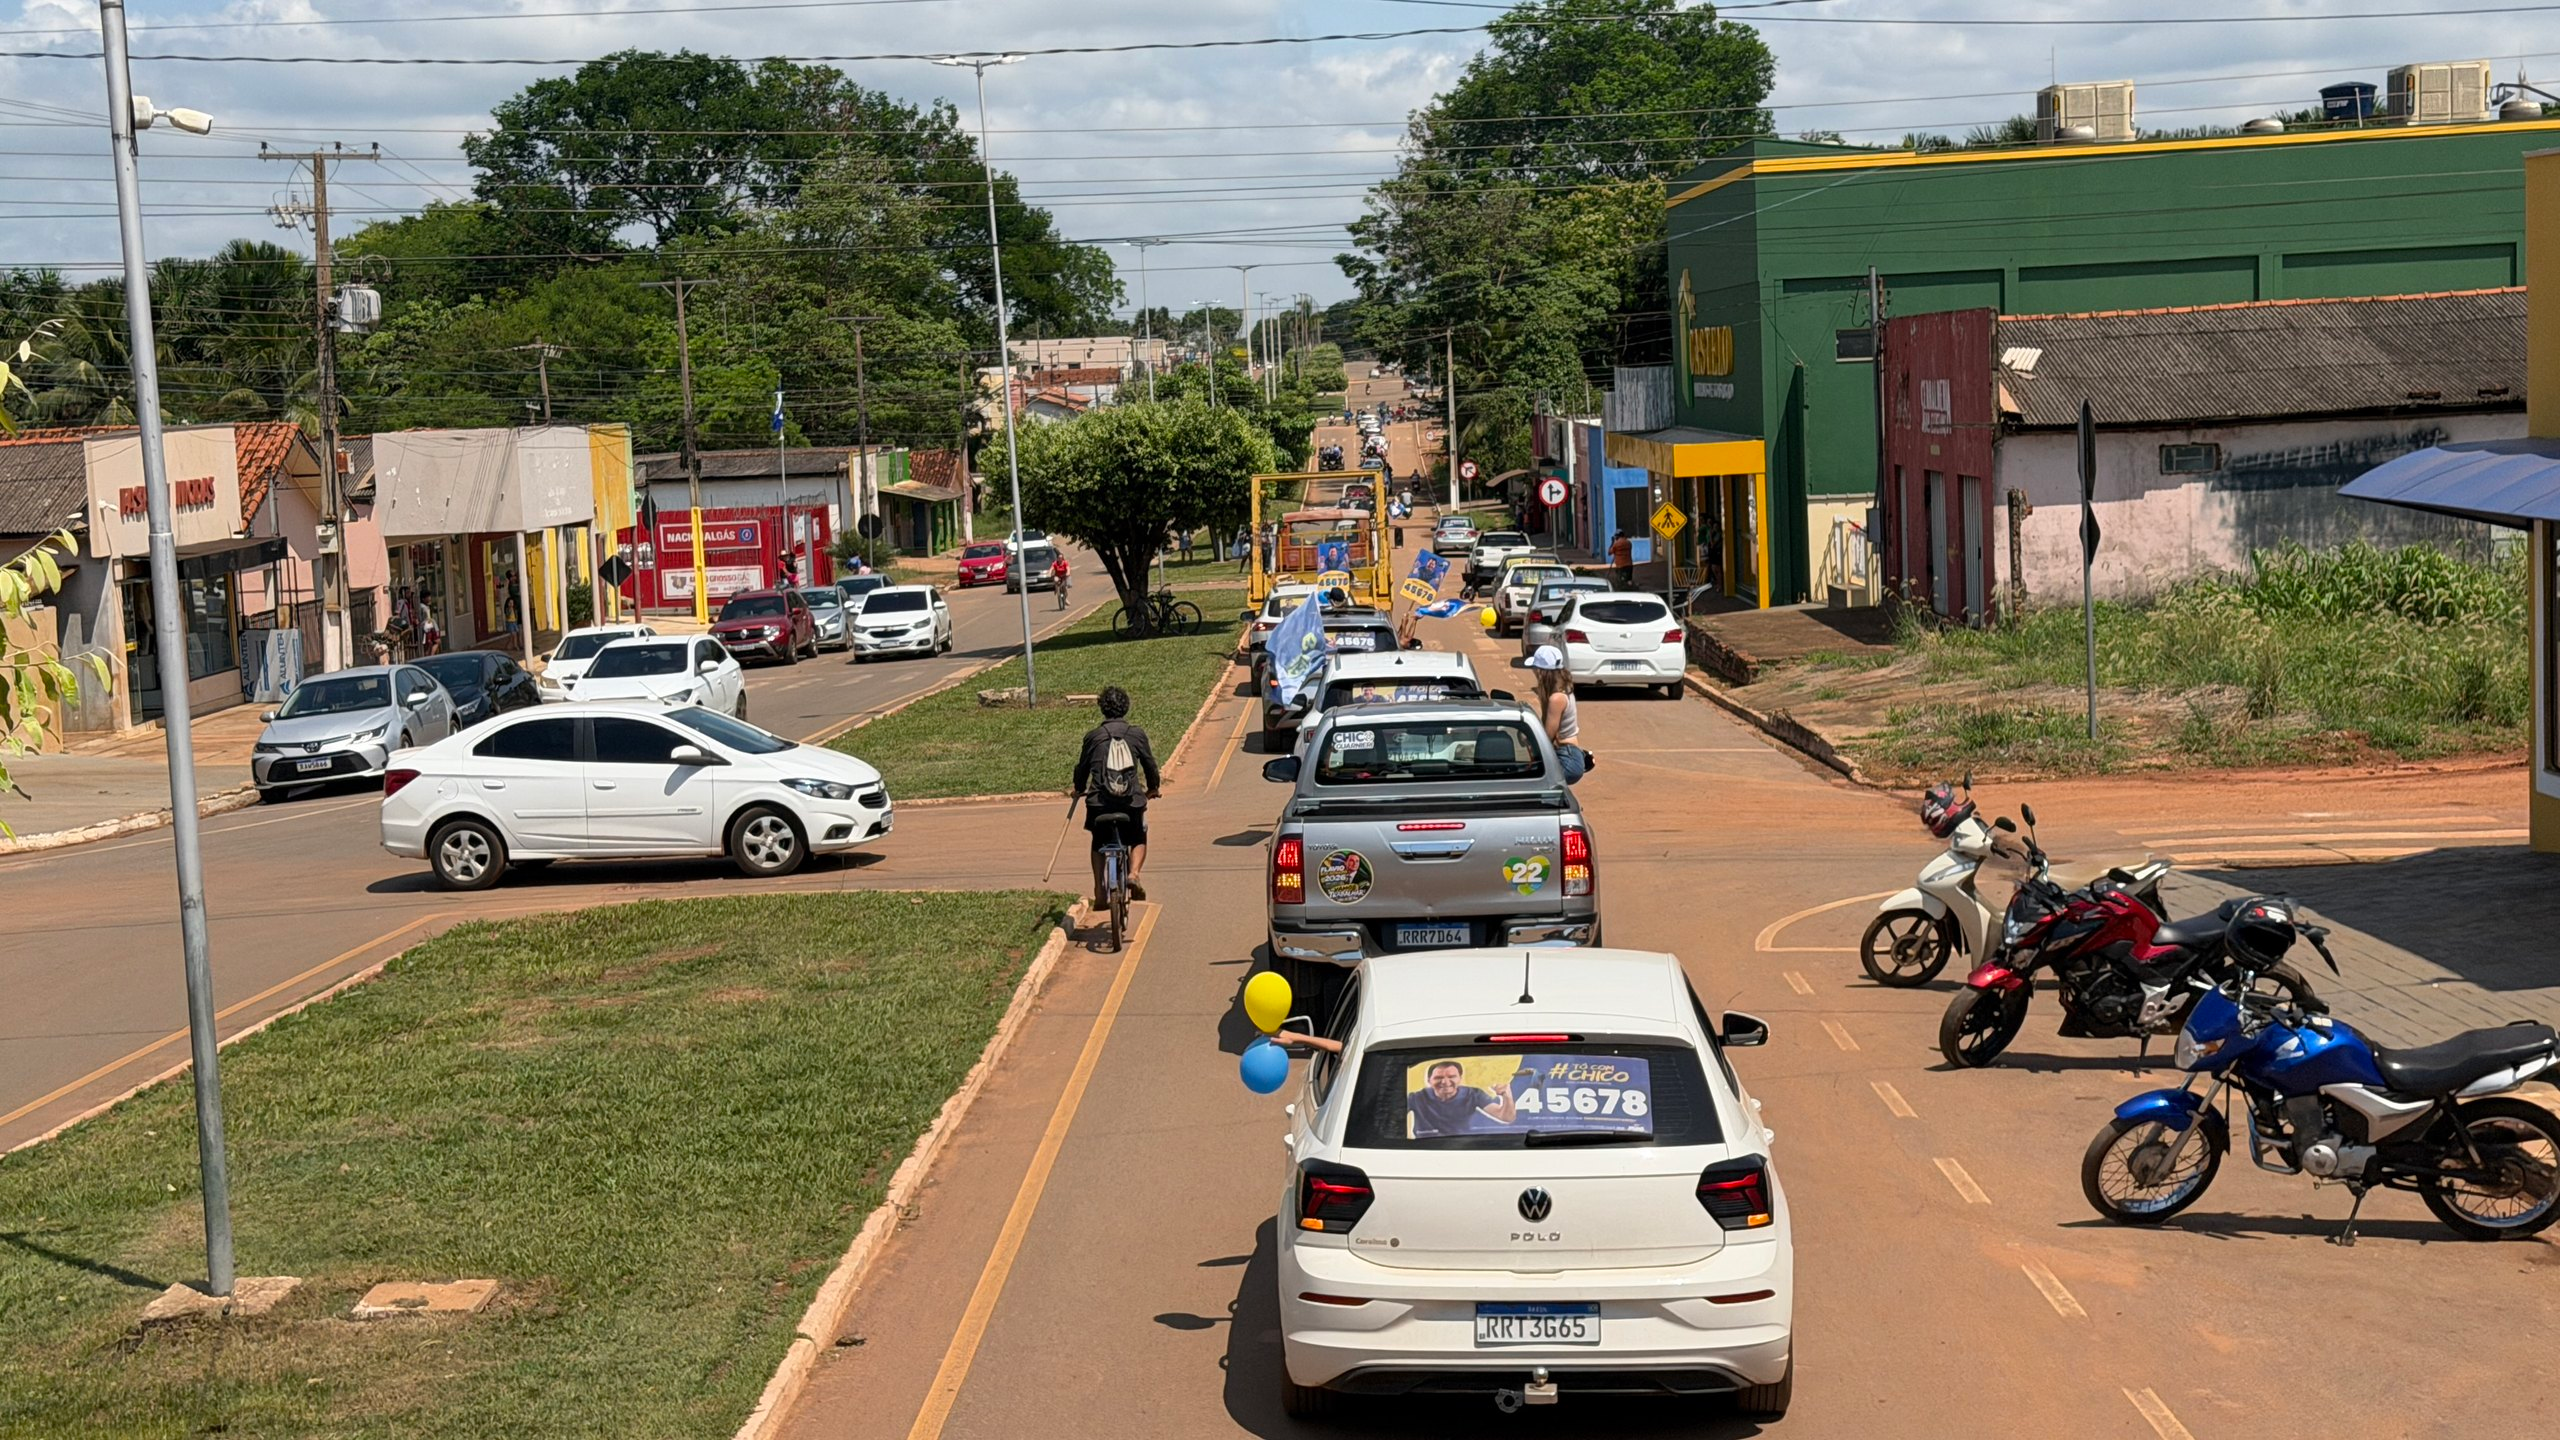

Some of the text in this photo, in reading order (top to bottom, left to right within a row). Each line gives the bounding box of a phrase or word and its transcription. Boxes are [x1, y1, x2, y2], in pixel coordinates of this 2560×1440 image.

[667, 529, 736, 543] NACIALGÁS
[1318, 577, 1349, 587] 45678
[1403, 583, 1434, 602] 45678
[1335, 637, 1376, 647] 45678
[1512, 862, 1543, 883] 22
[1402, 930, 1462, 944] RRR7D64
[1515, 1087, 1648, 1116] 45678
[1510, 1232, 1560, 1242] POLO
[1486, 1316, 1586, 1338] RRT3G65
